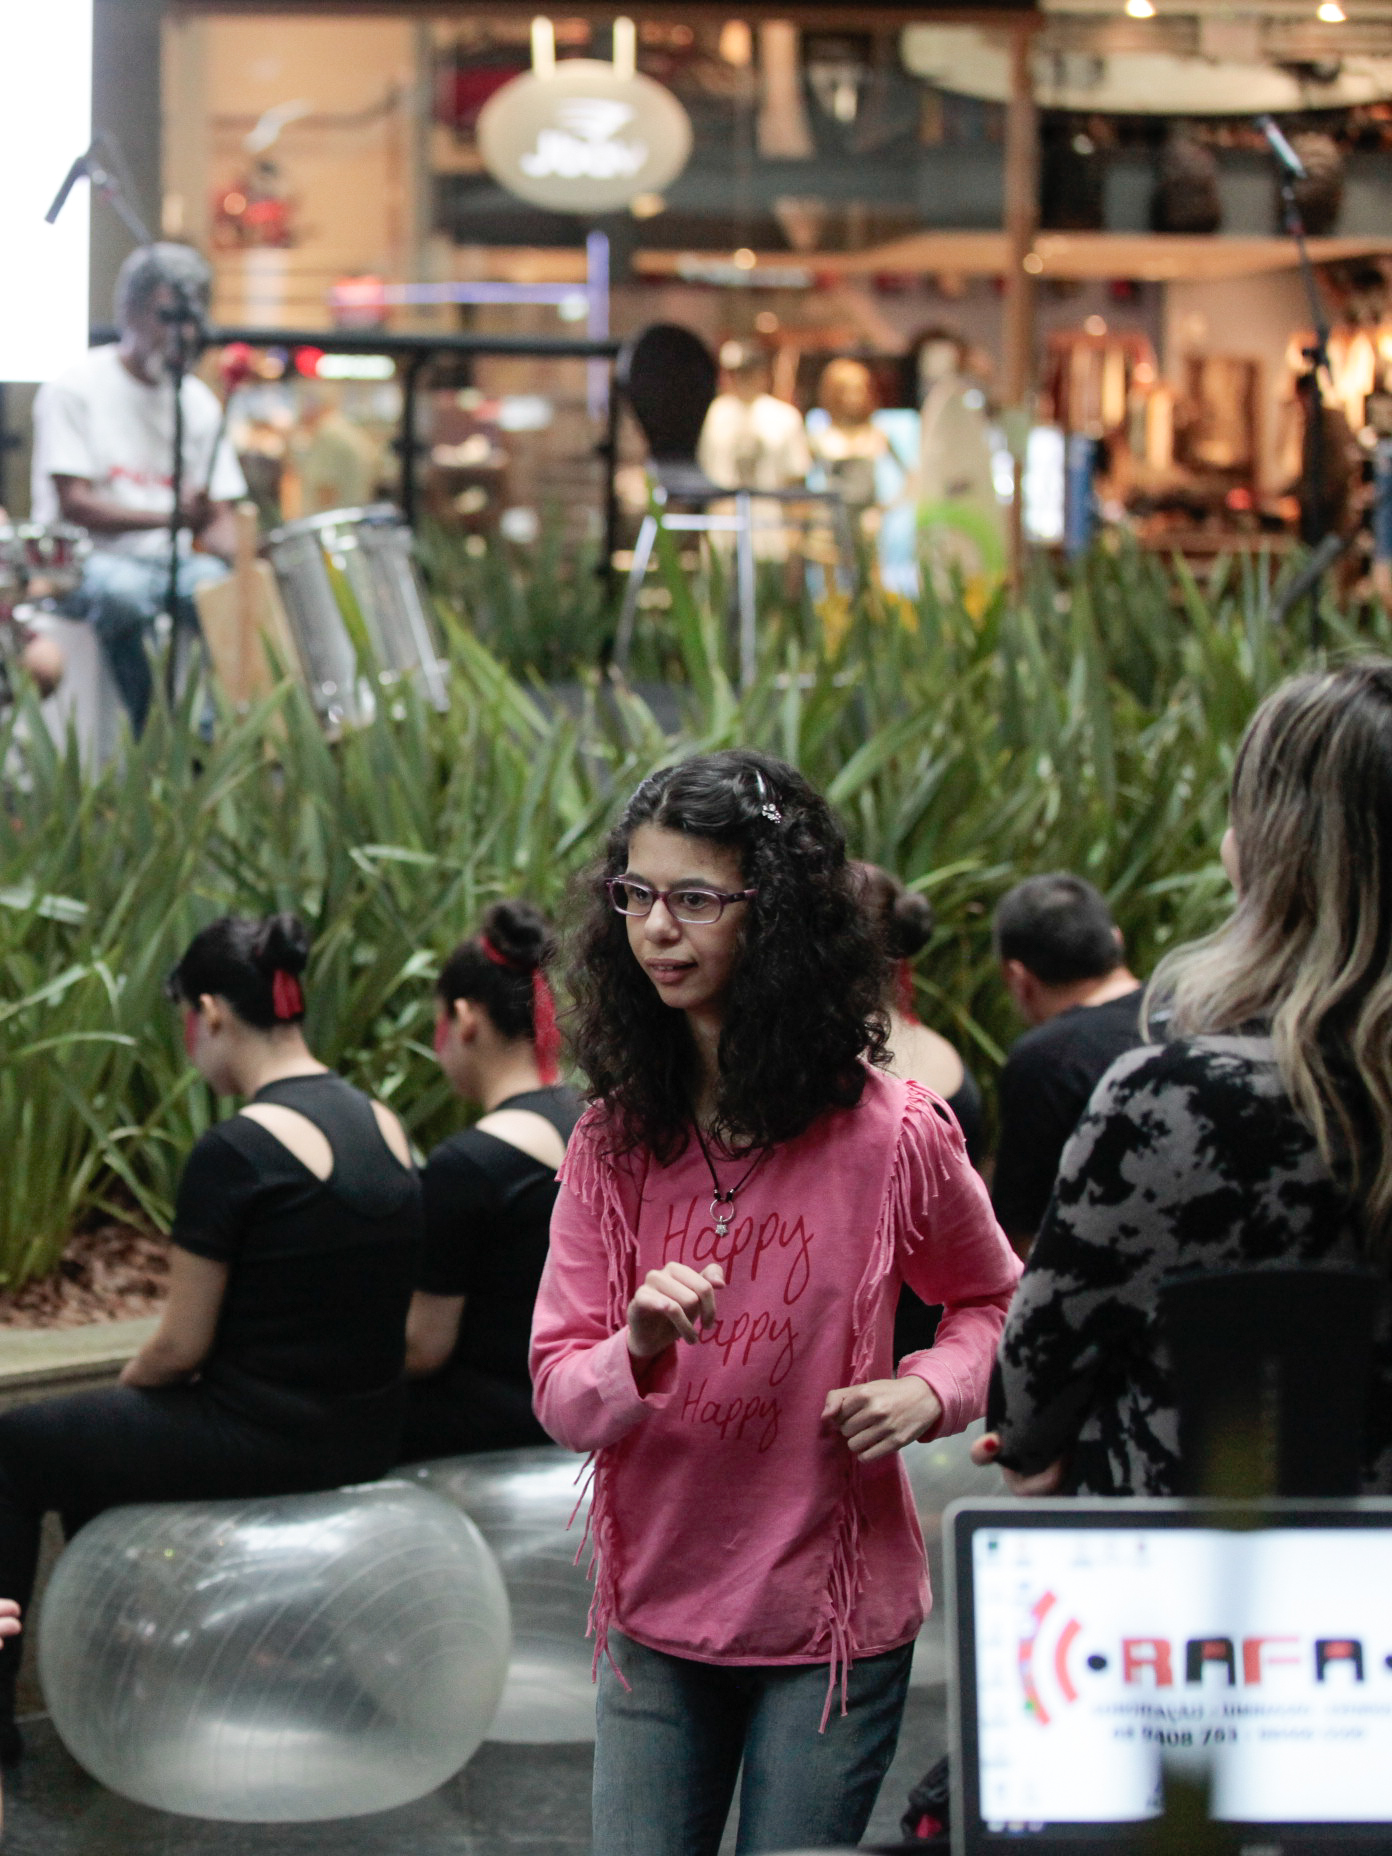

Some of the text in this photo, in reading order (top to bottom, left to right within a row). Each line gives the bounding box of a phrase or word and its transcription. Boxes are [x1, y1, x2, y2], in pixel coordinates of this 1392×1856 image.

[662, 1195, 814, 1305] Happy
[696, 1311, 799, 1387] appy
[680, 1378, 782, 1452] Happy
[1121, 1637, 1365, 1687] RAFA
